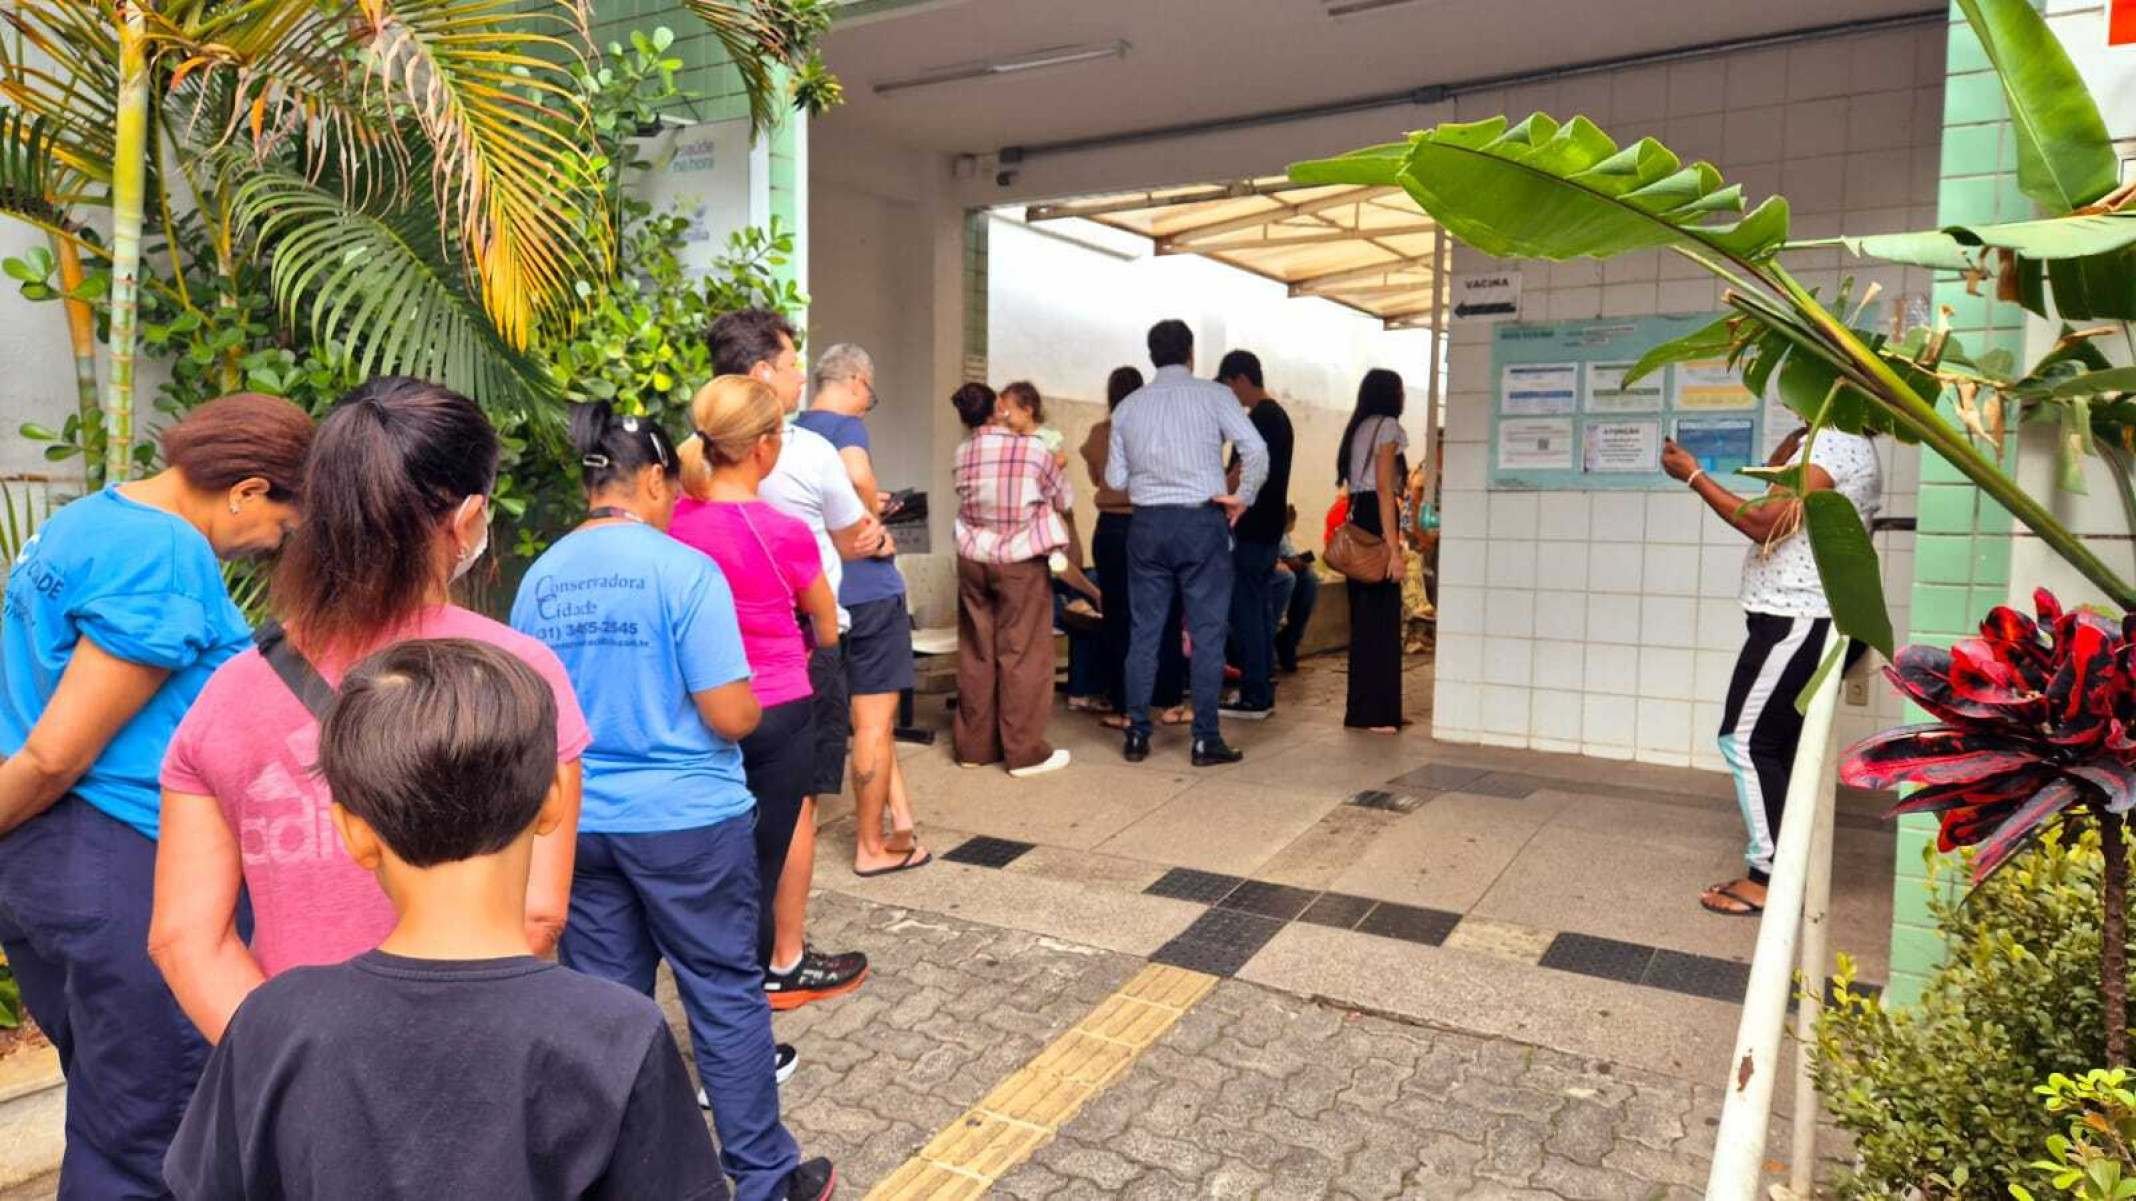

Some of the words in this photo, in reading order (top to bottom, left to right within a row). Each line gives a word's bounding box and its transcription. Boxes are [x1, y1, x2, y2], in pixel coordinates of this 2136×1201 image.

[1464, 278, 1510, 290] VACINA
[535, 573, 645, 600] Conservadora
[240, 796, 344, 865] adi
